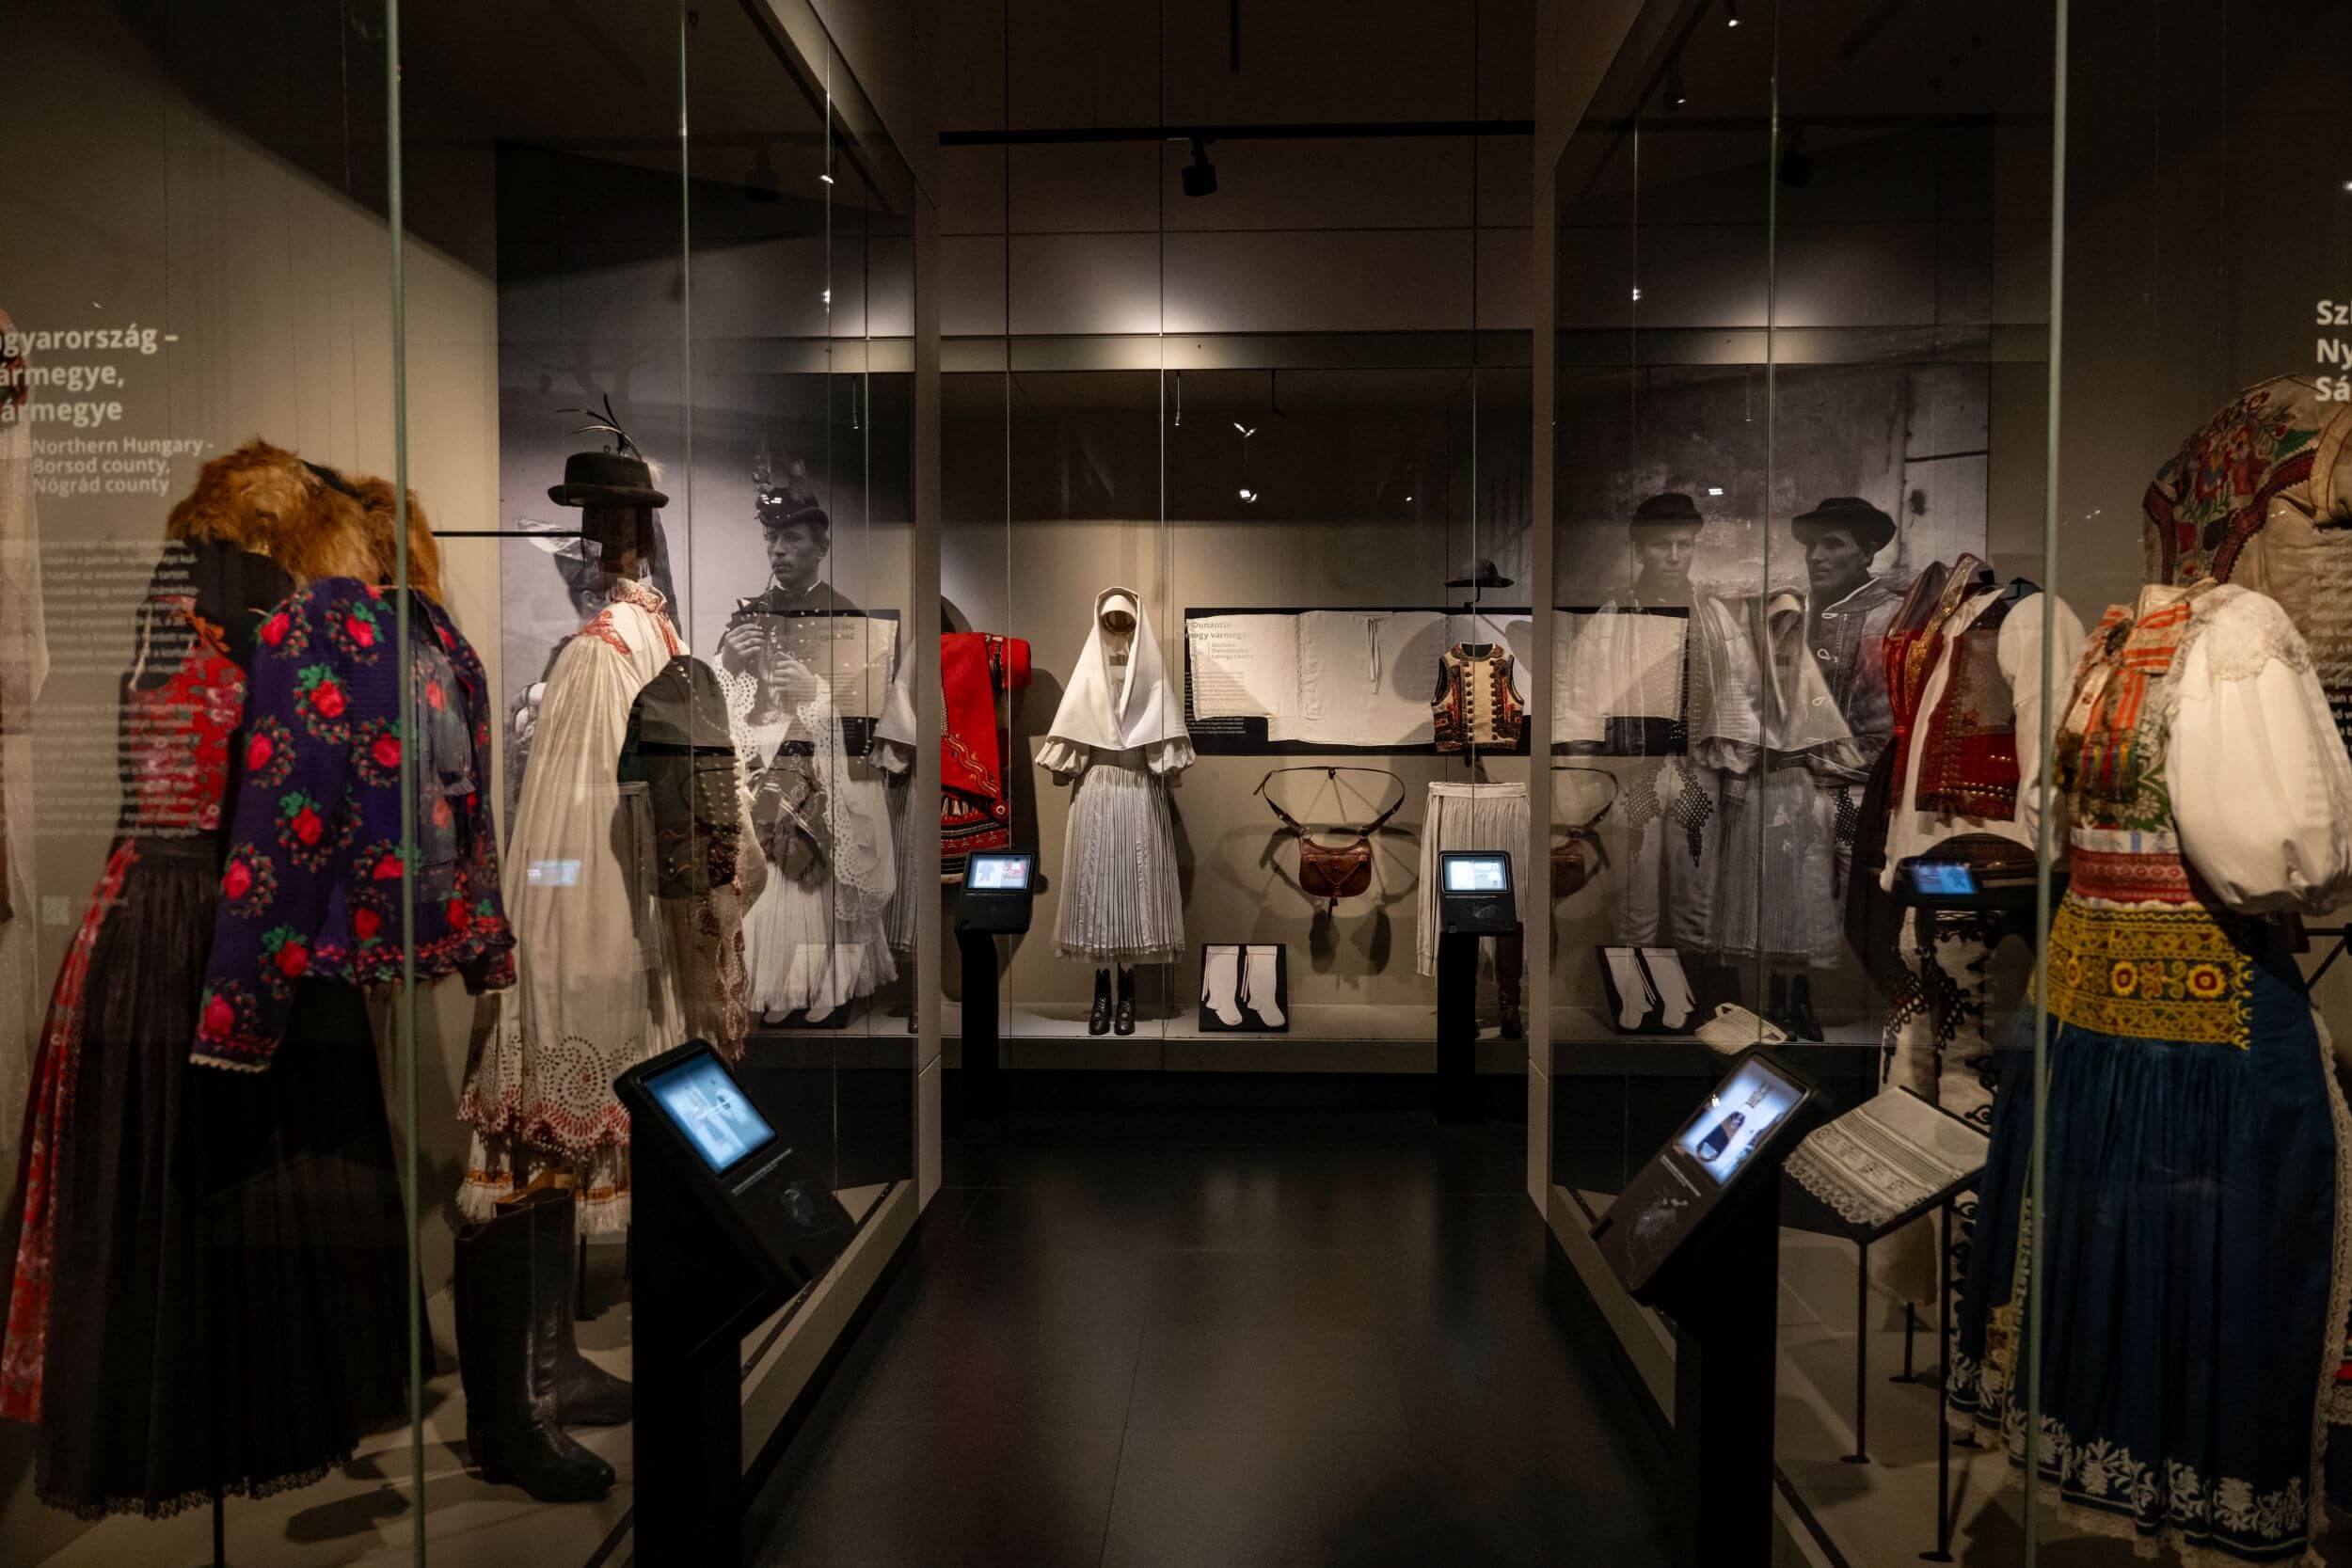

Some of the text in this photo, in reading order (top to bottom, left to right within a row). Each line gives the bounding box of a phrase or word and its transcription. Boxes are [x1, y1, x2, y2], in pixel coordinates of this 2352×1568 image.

[0, 323, 158, 356] gyarország
[32, 437, 118, 455] Northern
[122, 437, 203, 458] Hungary
[33, 457, 171, 478] Borsod county,
[34, 477, 170, 498] Nógrád county
